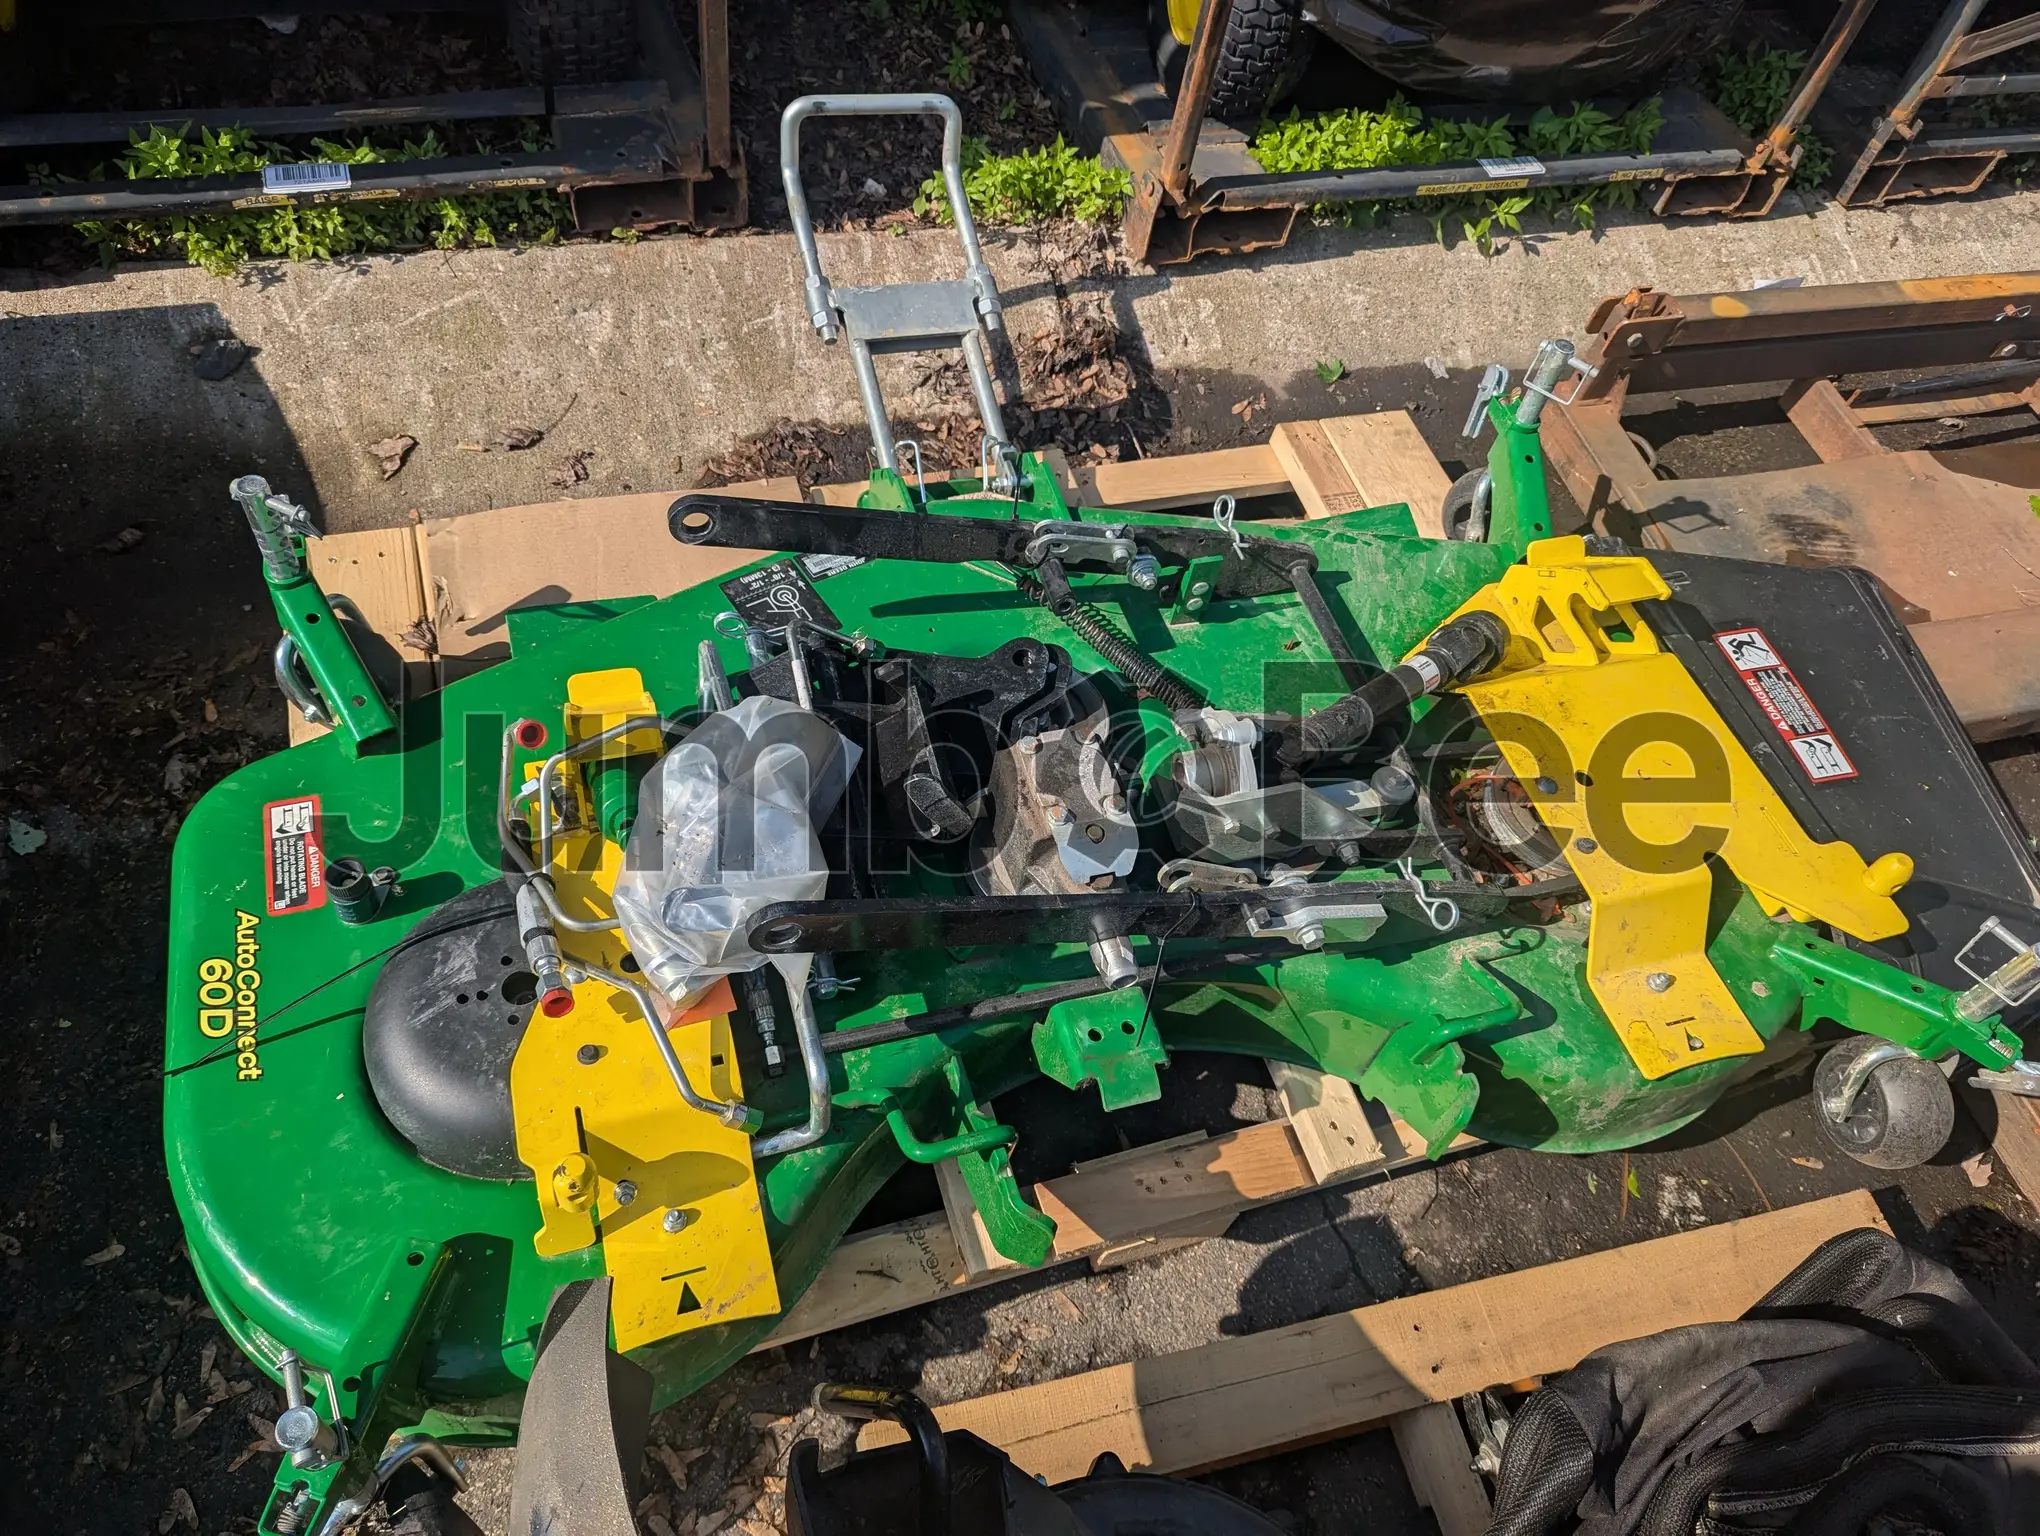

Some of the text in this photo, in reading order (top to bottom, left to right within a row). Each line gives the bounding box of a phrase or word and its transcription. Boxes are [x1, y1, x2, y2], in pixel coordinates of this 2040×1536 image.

[827, 564, 848, 577] DEERE
[1746, 678, 1781, 720] DANGER
[289, 837, 296, 845] Do
[297, 840, 307, 894] ROTATING BLADE
[310, 855, 321, 888] DANGER
[199, 958, 234, 1038] 60D
[235, 910, 263, 1081] AutoConnect
